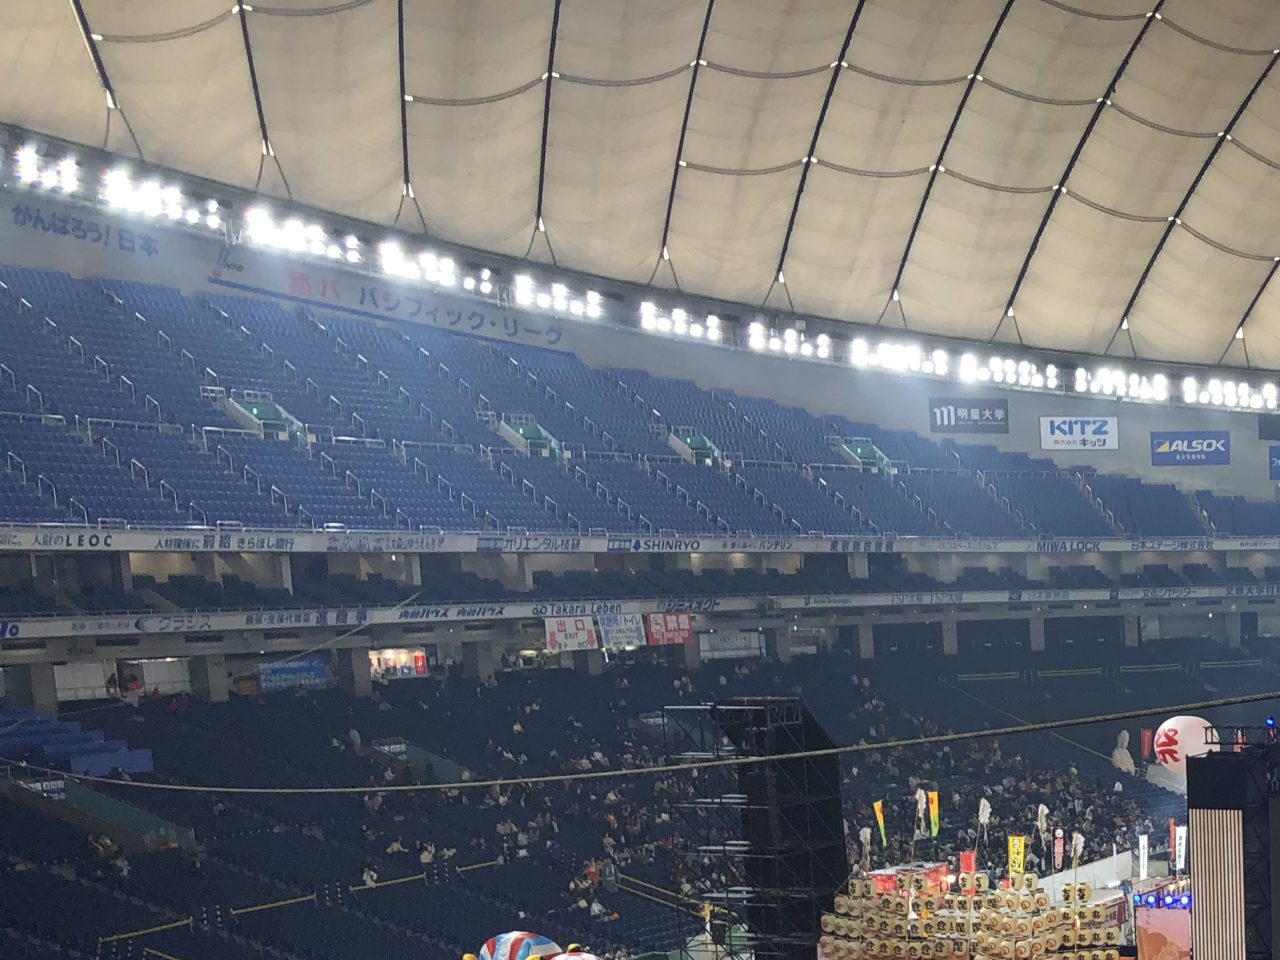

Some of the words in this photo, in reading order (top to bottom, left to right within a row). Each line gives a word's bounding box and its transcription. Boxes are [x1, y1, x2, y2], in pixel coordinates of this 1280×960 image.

[957, 408, 1004, 421] 明星大学
[1050, 420, 1108, 436] KITZ
[1171, 439, 1226, 452] ALSOK
[643, 540, 700, 550] SHINRYO
[1037, 541, 1066, 551] MIWA
[1069, 541, 1100, 551] LOCK
[550, 604, 586, 615] Takara
[591, 602, 622, 613] Leben
